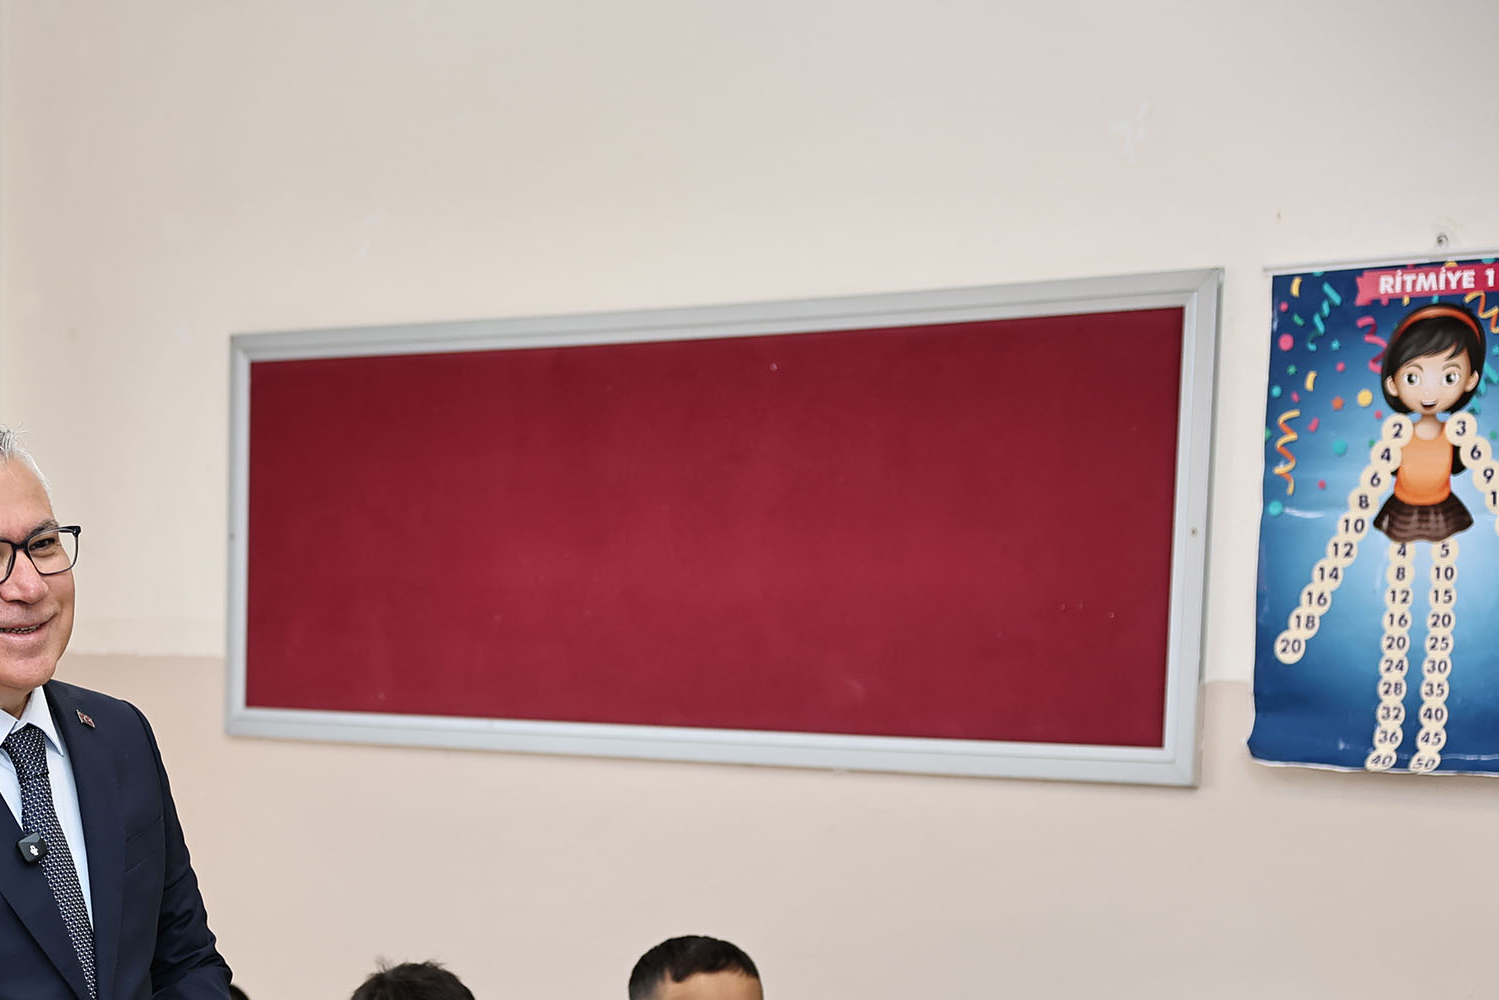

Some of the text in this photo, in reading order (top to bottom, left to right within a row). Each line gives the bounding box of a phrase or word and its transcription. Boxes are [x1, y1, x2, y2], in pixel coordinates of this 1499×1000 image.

[1380, 266, 1476, 294] RİTMİYE
[1392, 422, 1403, 439] 2
[1455, 420, 1466, 436] 3
[1381, 447, 1391, 462] 4
[1470, 444, 1482, 460] 6
[1370, 471, 1381, 487] 6
[1483, 468, 1494, 484] 9
[1359, 494, 1369, 509] 8
[1344, 518, 1365, 533] 10
[1333, 542, 1354, 558] 12
[1397, 543, 1406, 558] 4
[1440, 541, 1449, 558] 5
[1319, 566, 1338, 581] 14
[1396, 567, 1406, 581] 8
[1435, 566, 1454, 581] 10
[1307, 591, 1327, 607] 16
[1390, 590, 1409, 604] 12
[1434, 589, 1452, 604] 15
[1296, 615, 1315, 630] 18
[1389, 613, 1408, 627] 16
[1431, 613, 1451, 628] 20
[1280, 639, 1301, 654] 20
[1386, 636, 1406, 650] 20
[1429, 636, 1449, 651] 25
[1384, 659, 1404, 673] 24
[1427, 660, 1447, 674] 30
[1383, 681, 1402, 696] 28
[1425, 682, 1444, 697] 35
[1381, 706, 1400, 720] 32
[1423, 707, 1444, 722] 40
[1379, 730, 1398, 744] 36
[1421, 732, 1442, 746] 45
[1371, 755, 1392, 767] 40
[1412, 756, 1436, 770] 50
